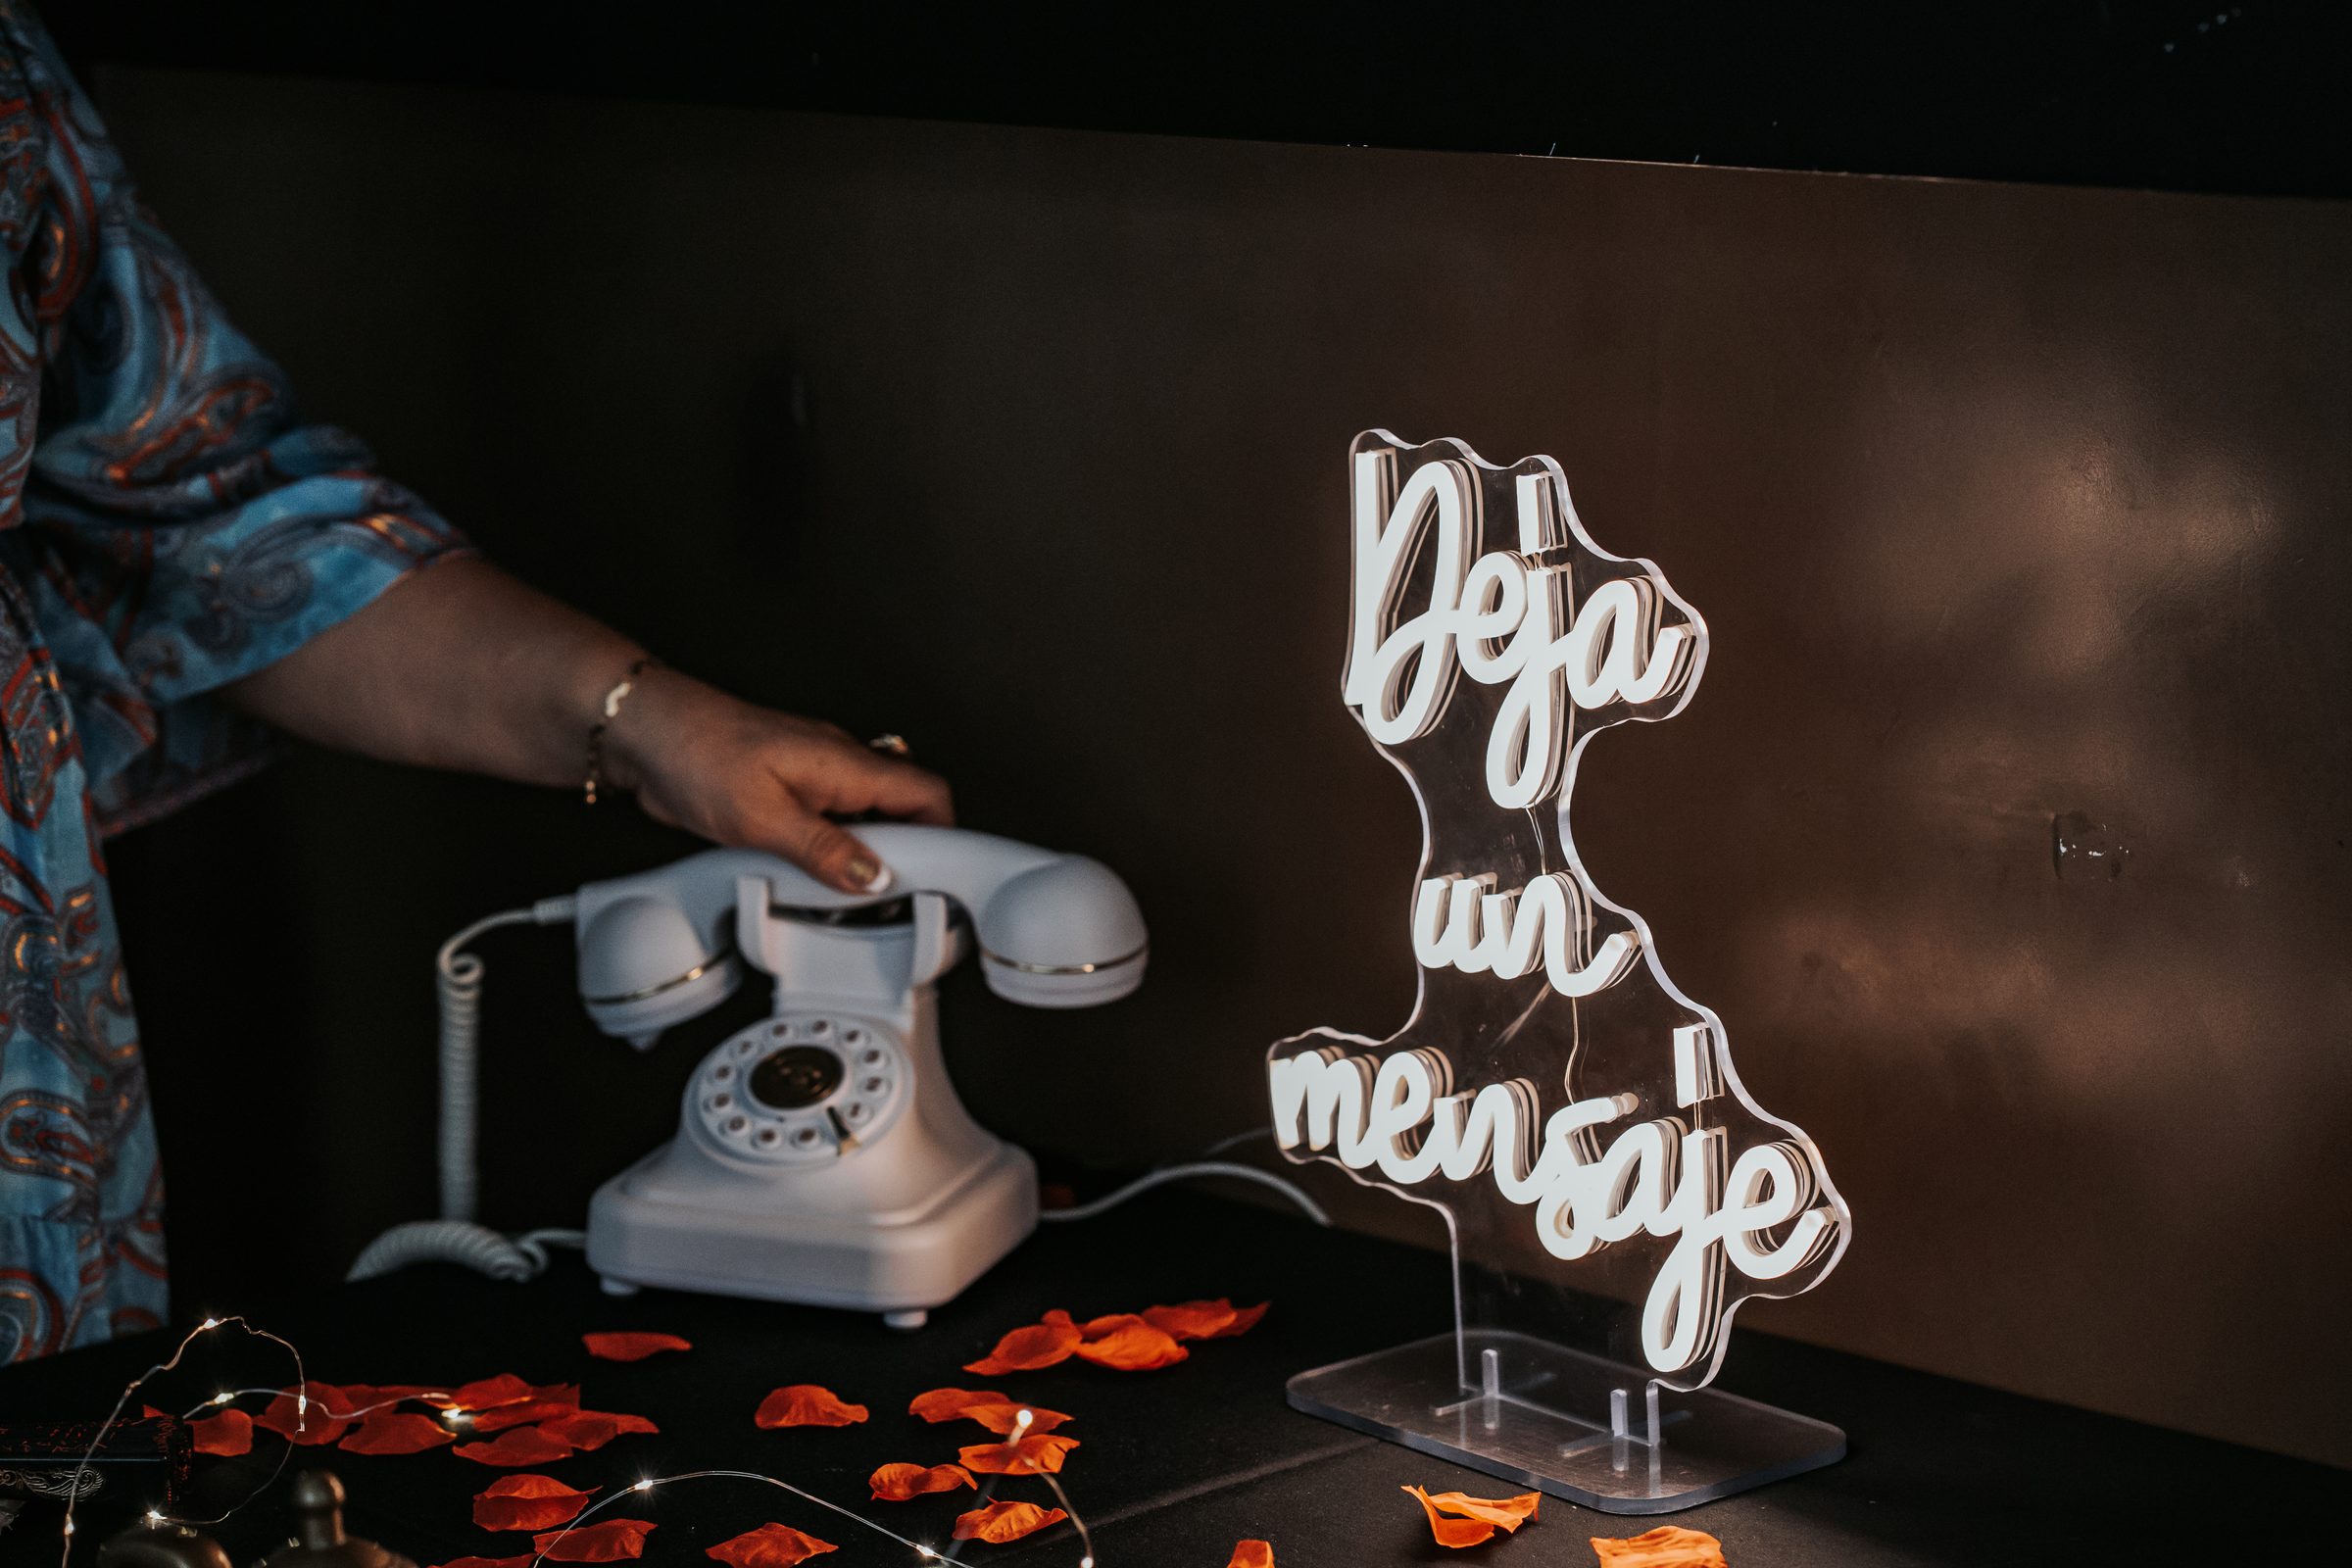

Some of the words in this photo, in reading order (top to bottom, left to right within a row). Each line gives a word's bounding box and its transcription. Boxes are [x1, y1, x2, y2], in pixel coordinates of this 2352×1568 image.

[1346, 449, 1695, 809] Deja
[1414, 871, 1638, 998] un
[1270, 1023, 1836, 1373] mensaje
